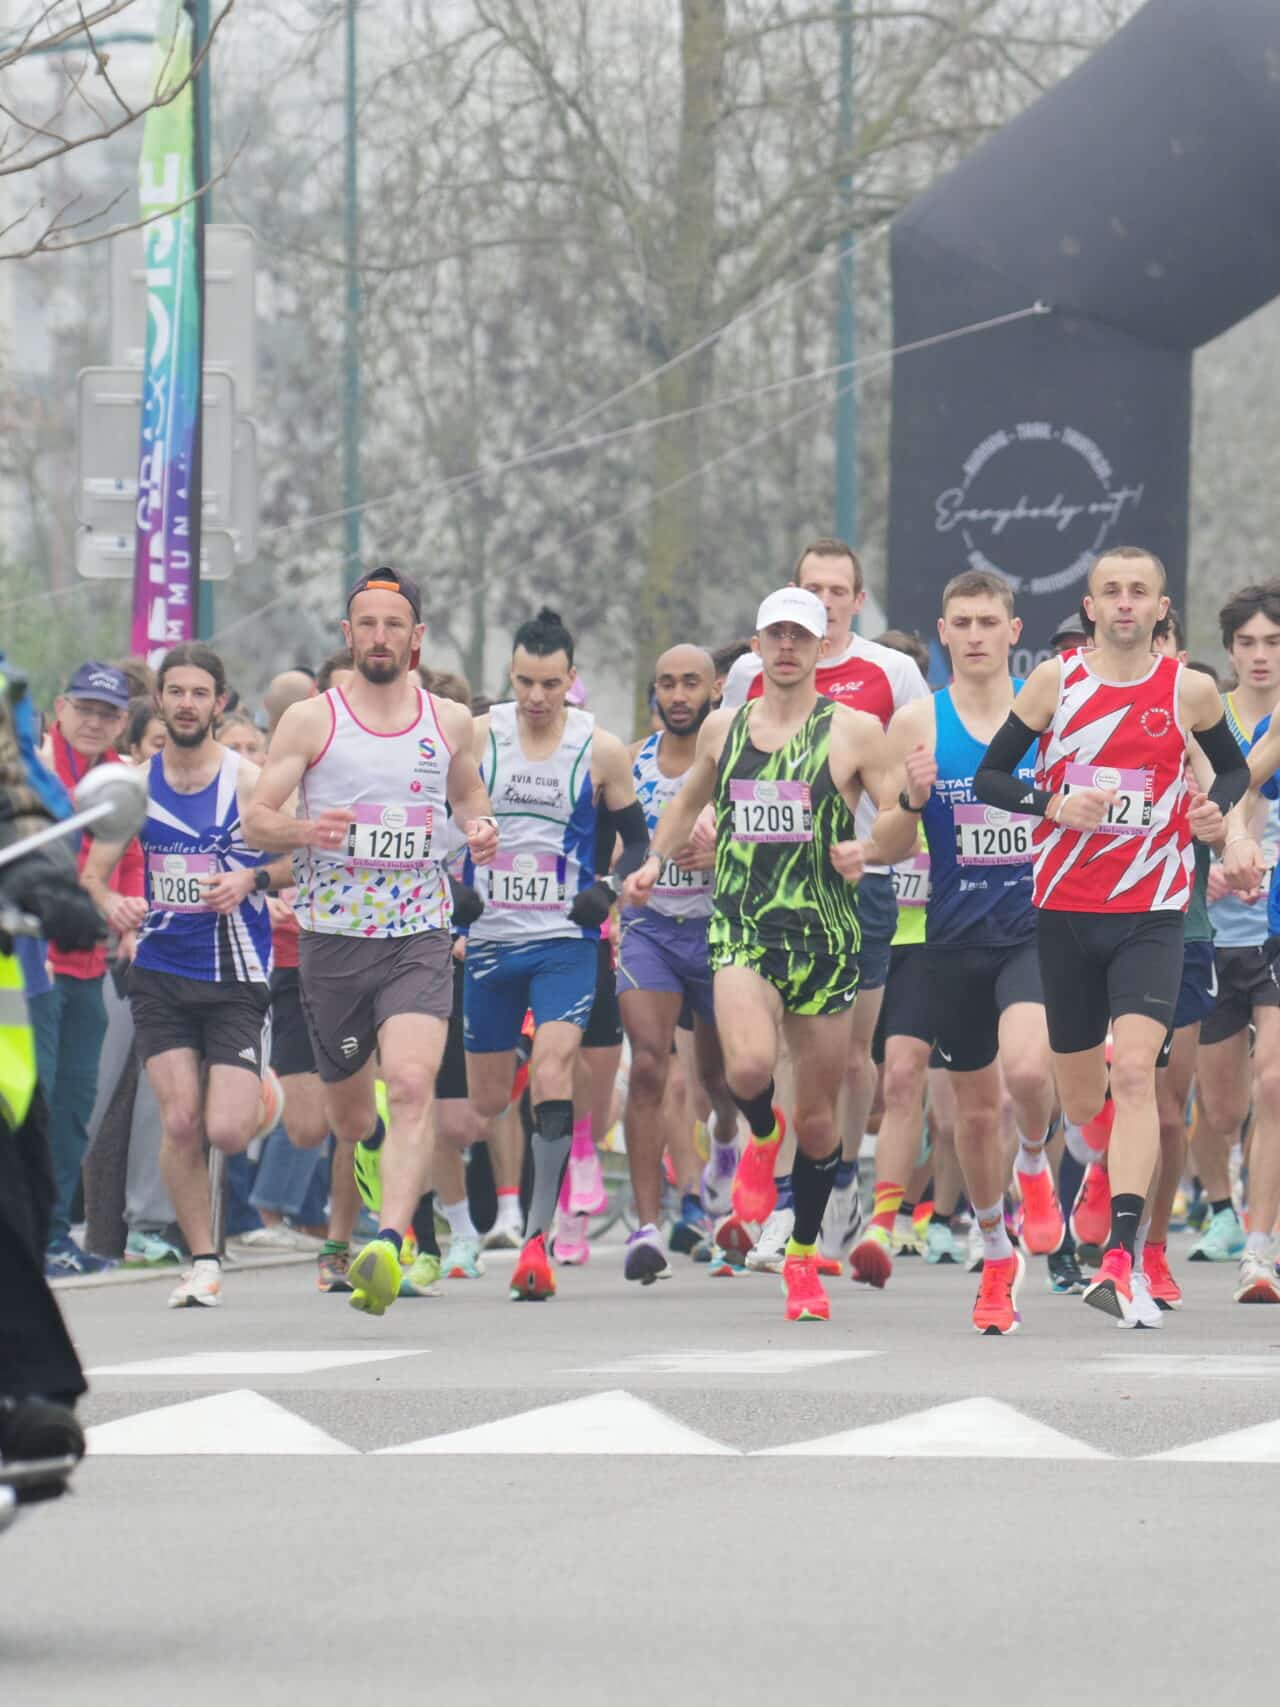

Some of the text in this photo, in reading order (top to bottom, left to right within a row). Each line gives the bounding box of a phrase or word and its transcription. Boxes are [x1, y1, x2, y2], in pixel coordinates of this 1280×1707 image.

[535, 776, 560, 788] CLUB
[743, 805, 794, 832] 1209
[1107, 795, 1131, 824] 12
[369, 829, 415, 859] 1215
[971, 826, 1027, 855] 1206
[160, 878, 200, 903] 1286
[504, 876, 549, 902] 1547
